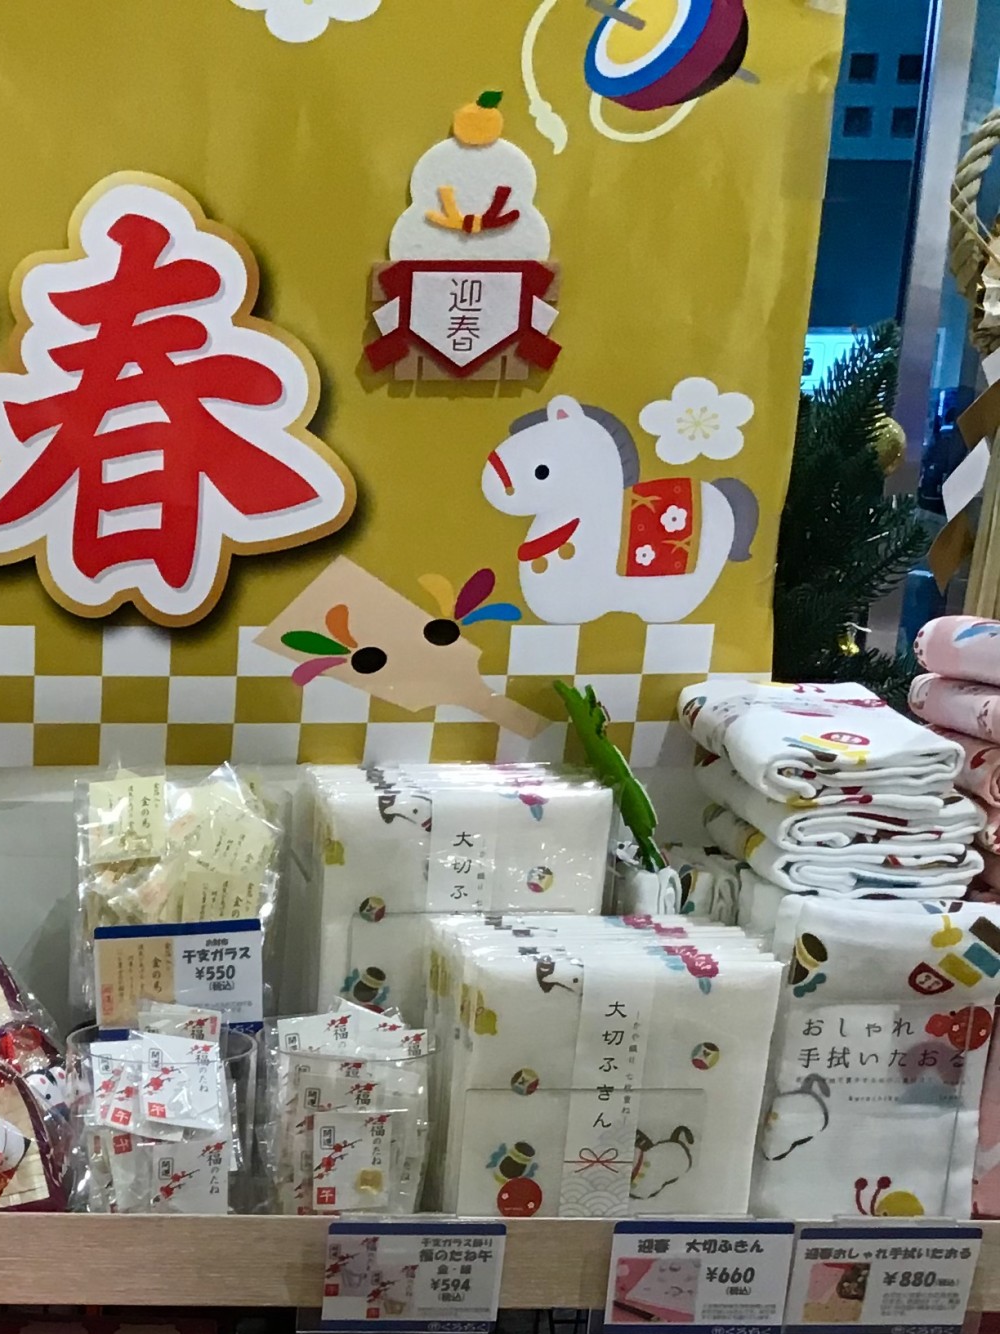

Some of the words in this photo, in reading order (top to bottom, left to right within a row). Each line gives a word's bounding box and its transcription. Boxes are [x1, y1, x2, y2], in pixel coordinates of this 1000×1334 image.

[447, 277, 483, 352] 迎春
[450, 831, 474, 914] 大切ふ
[182, 947, 251, 963] 干支ガラス
[195, 964, 236, 981] ¥550
[801, 1016, 915, 1038] おしゃれ
[592, 1000, 628, 1128] 大切ふきん
[797, 1046, 966, 1069] 手拭いたおる
[113, 1109, 130, 1124] 午
[370, 1123, 386, 1166] 福のたね
[206, 1152, 222, 1195] 福のたね
[319, 1188, 333, 1203] 午
[685, 1238, 765, 1255] 大切ふきん
[705, 1266, 756, 1284] ¥660
[882, 1270, 936, 1288] ¥880
[430, 1278, 471, 1292] ¥594
